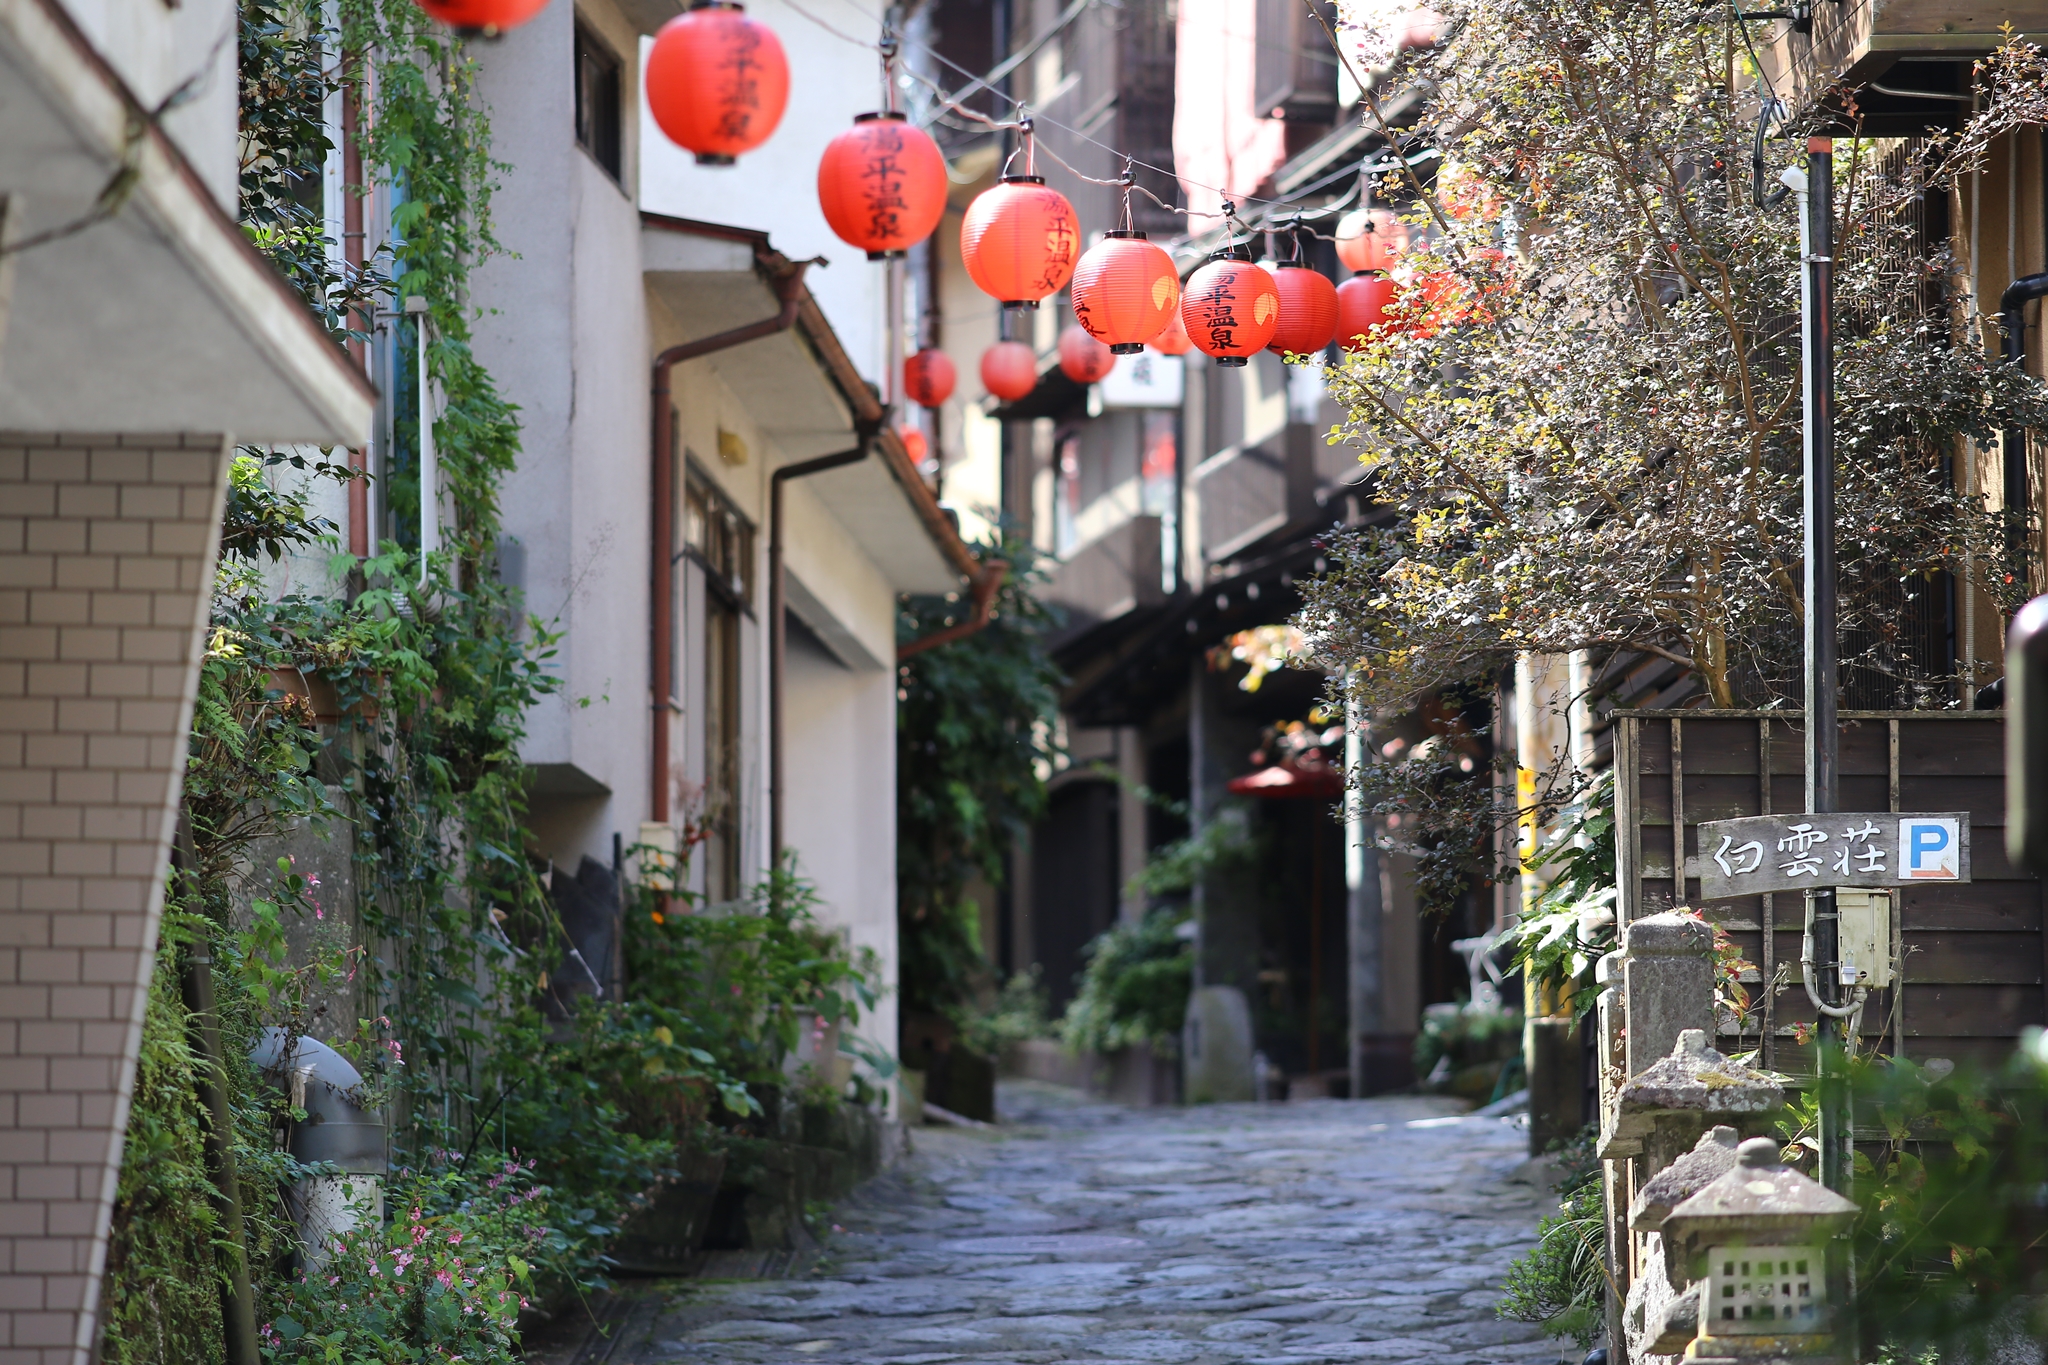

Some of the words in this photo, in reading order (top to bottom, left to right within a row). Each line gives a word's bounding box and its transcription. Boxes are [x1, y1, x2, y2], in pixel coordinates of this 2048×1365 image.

[860, 127, 908, 239] 湯平温泉
[1031, 191, 1073, 290] 湯平温泉
[1713, 819, 1887, 878] 白雲荘
[1910, 824, 1949, 868] P
